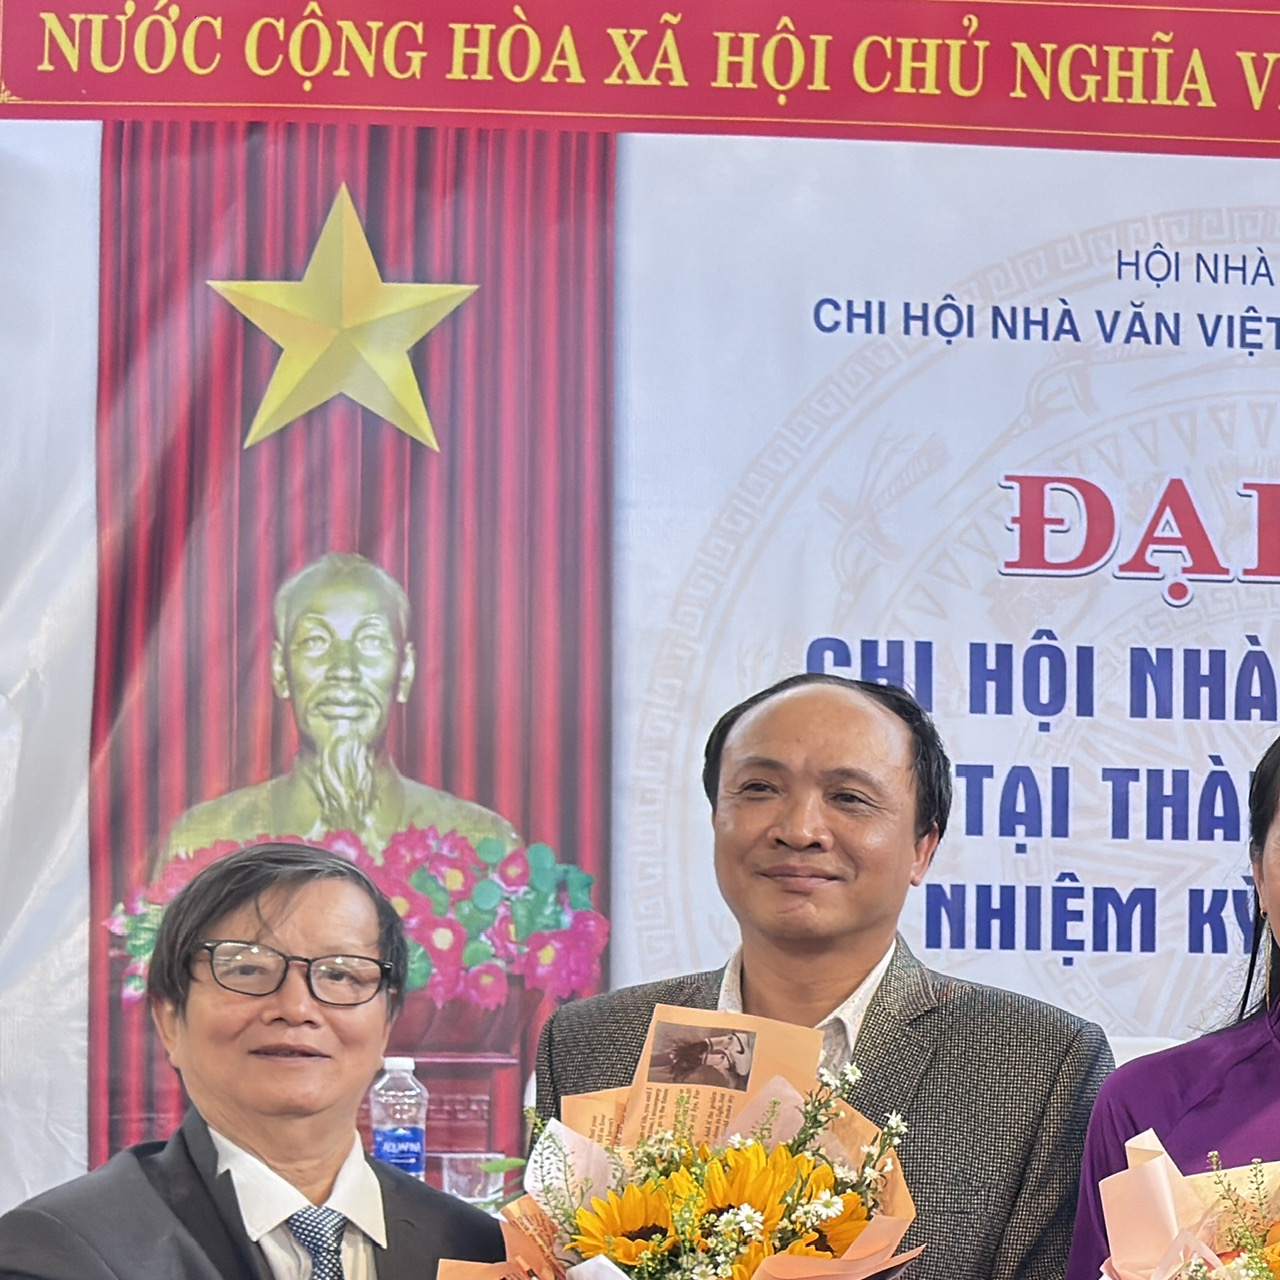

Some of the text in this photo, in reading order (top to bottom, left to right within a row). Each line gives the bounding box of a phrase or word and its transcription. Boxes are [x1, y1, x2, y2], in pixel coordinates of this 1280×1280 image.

[39, 0, 223, 77] NƯỚC
[245, 1, 426, 100] CỘNG
[446, 5, 584, 84] HÒA
[604, 13, 688, 87] XÃ
[712, 17, 831, 106] HỘI
[852, 14, 989, 98] CHỦ
[1009, 32, 1216, 109] NGHĨA
[1116, 242, 1180, 288] HỘI
[1195, 247, 1276, 287] NHÀ
[813, 297, 886, 335] CHI
[903, 294, 974, 345] HỘI
[991, 298, 1081, 343] NHÀ
[1095, 301, 1181, 346] VĂN
[969, 629, 1094, 732] HỘI
[1130, 635, 1278, 721] NHÀ
[956, 755, 1256, 854] TẠI THÀ
[925, 872, 1156, 967] NHIỆM
